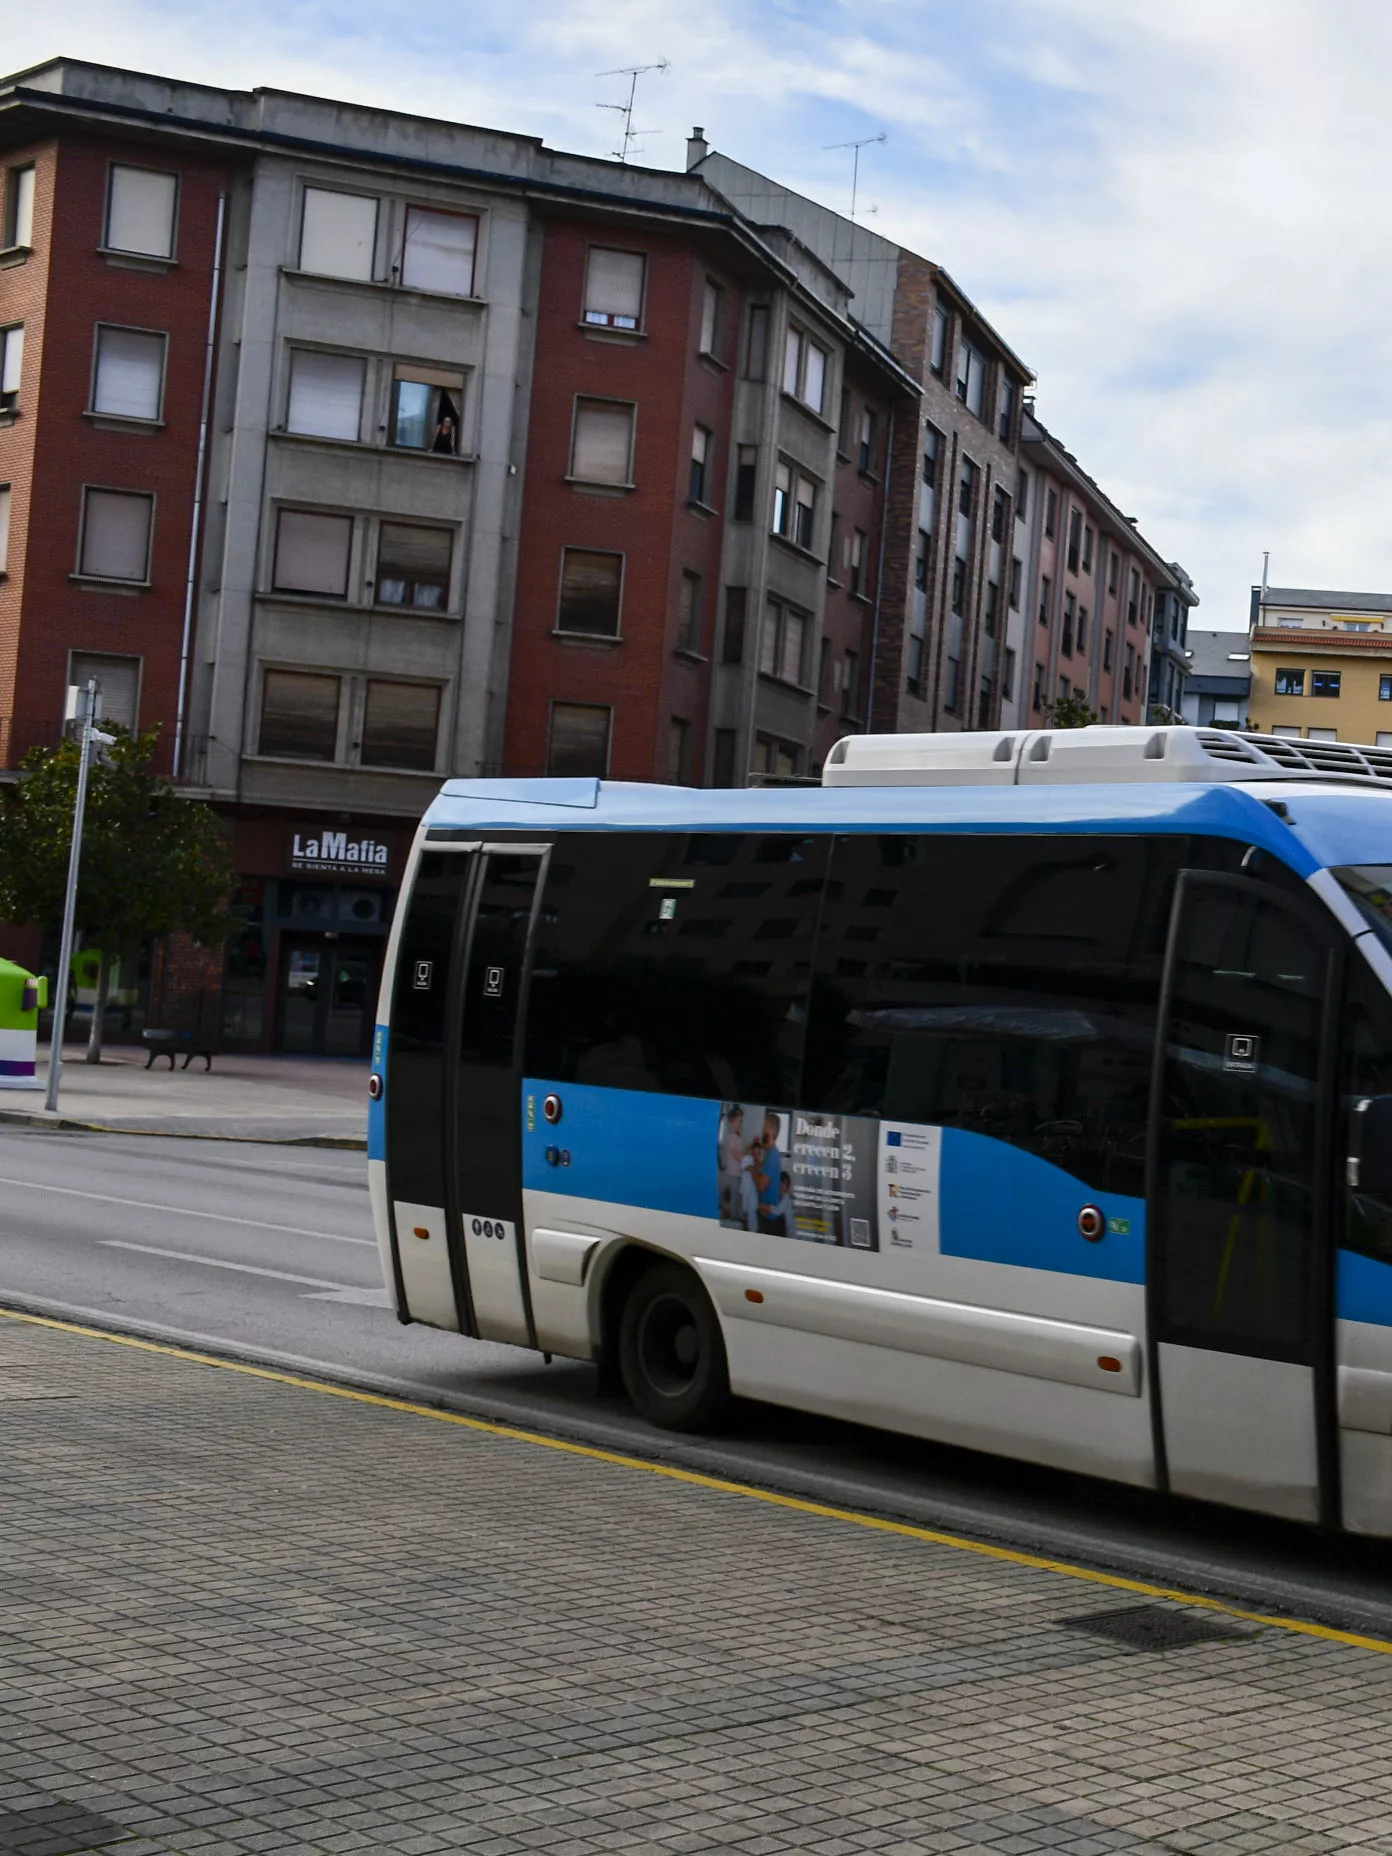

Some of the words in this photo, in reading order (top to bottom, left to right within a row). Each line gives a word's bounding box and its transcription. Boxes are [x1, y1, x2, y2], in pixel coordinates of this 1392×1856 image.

[306, 863, 337, 872] SIENTA
[793, 1143, 839, 1160] crecen
[793, 1162, 839, 1179] crecen
[842, 1164, 853, 1181] 3
